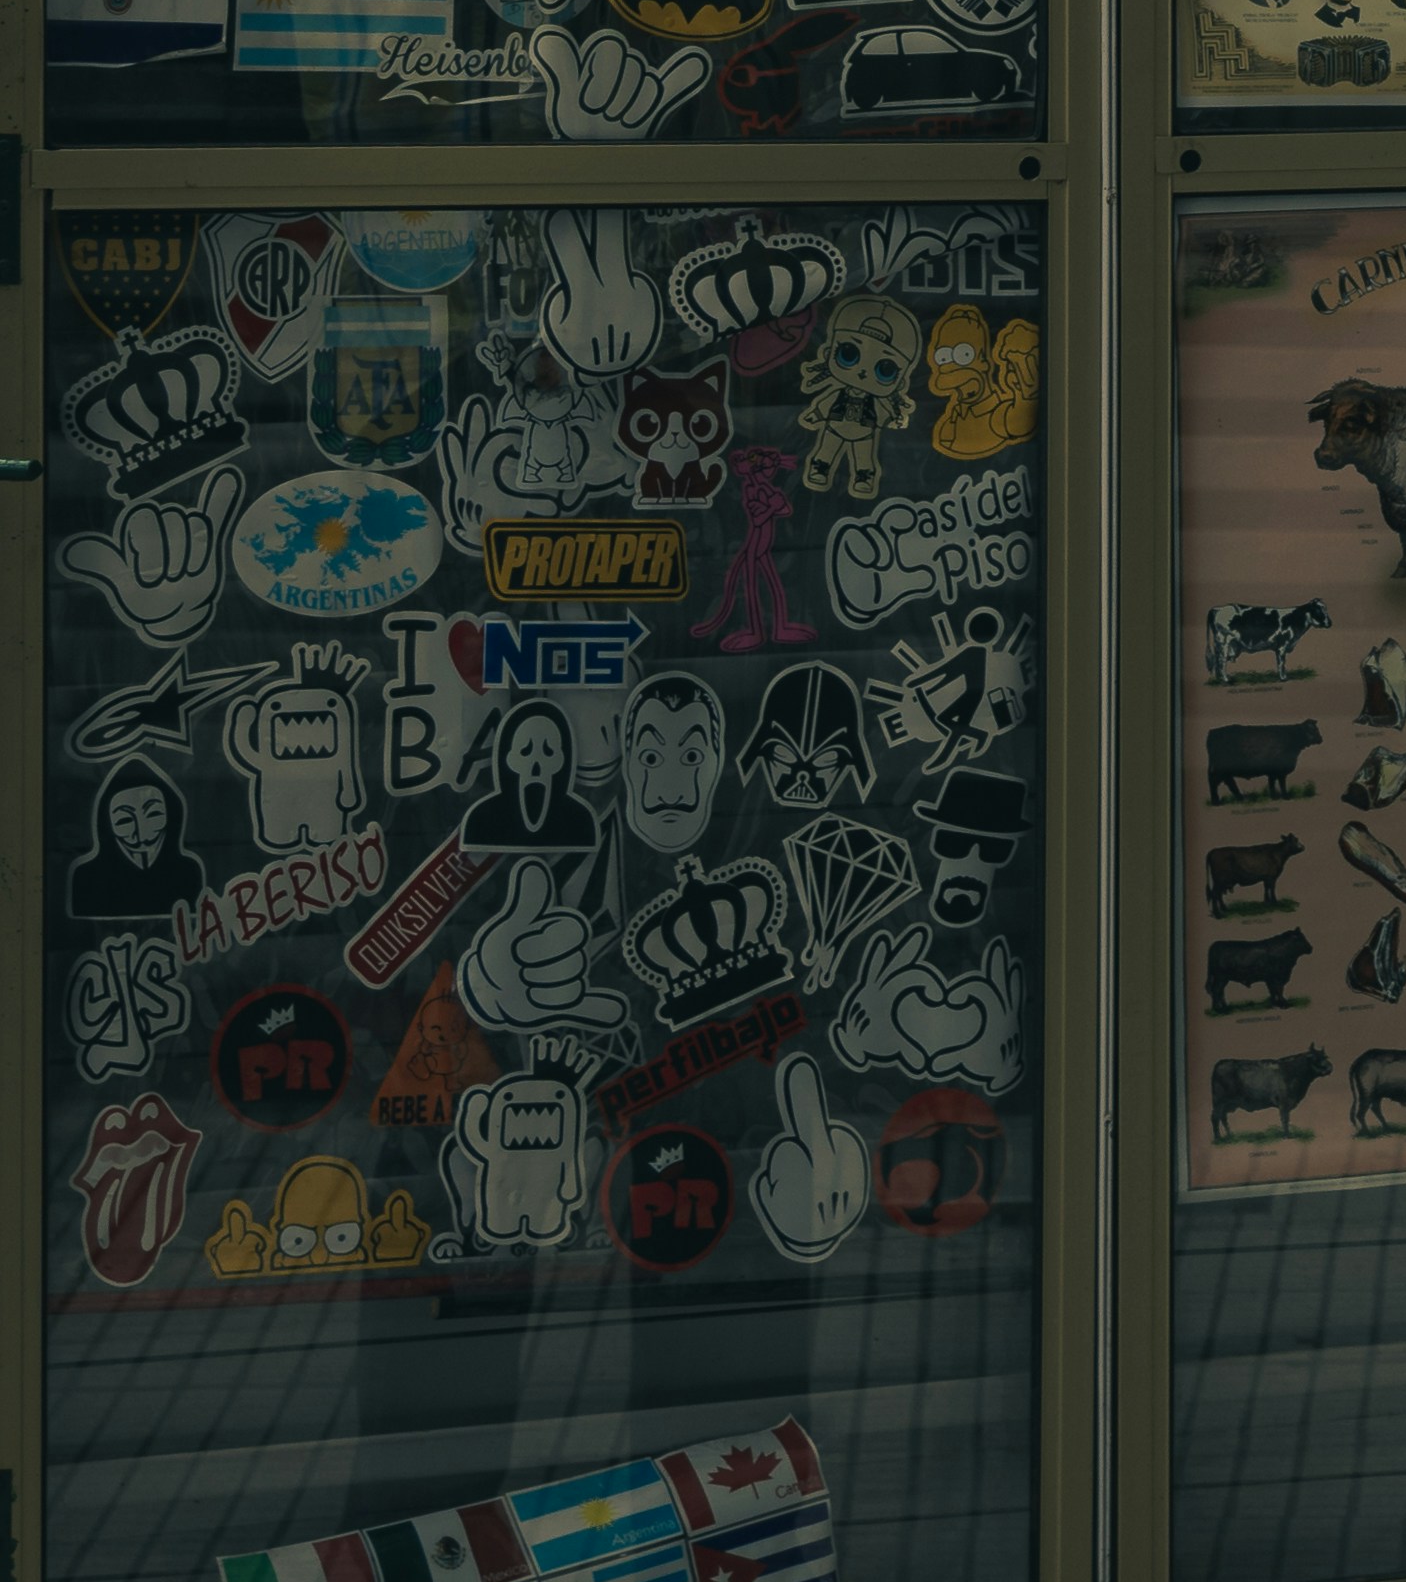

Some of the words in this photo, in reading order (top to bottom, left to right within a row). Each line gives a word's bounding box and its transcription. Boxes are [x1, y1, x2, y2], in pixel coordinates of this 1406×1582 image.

[71, 237, 182, 272] CABJ
[266, 567, 419, 612] ARGENTINAS
[501, 534, 678, 588] PROTAPER
[179, 896, 223, 960] LA
[230, 832, 387, 943] BERISO
[359, 851, 474, 975] QUIKSILVER
[238, 1038, 335, 1102] PR
[629, 1178, 719, 1238] PR
